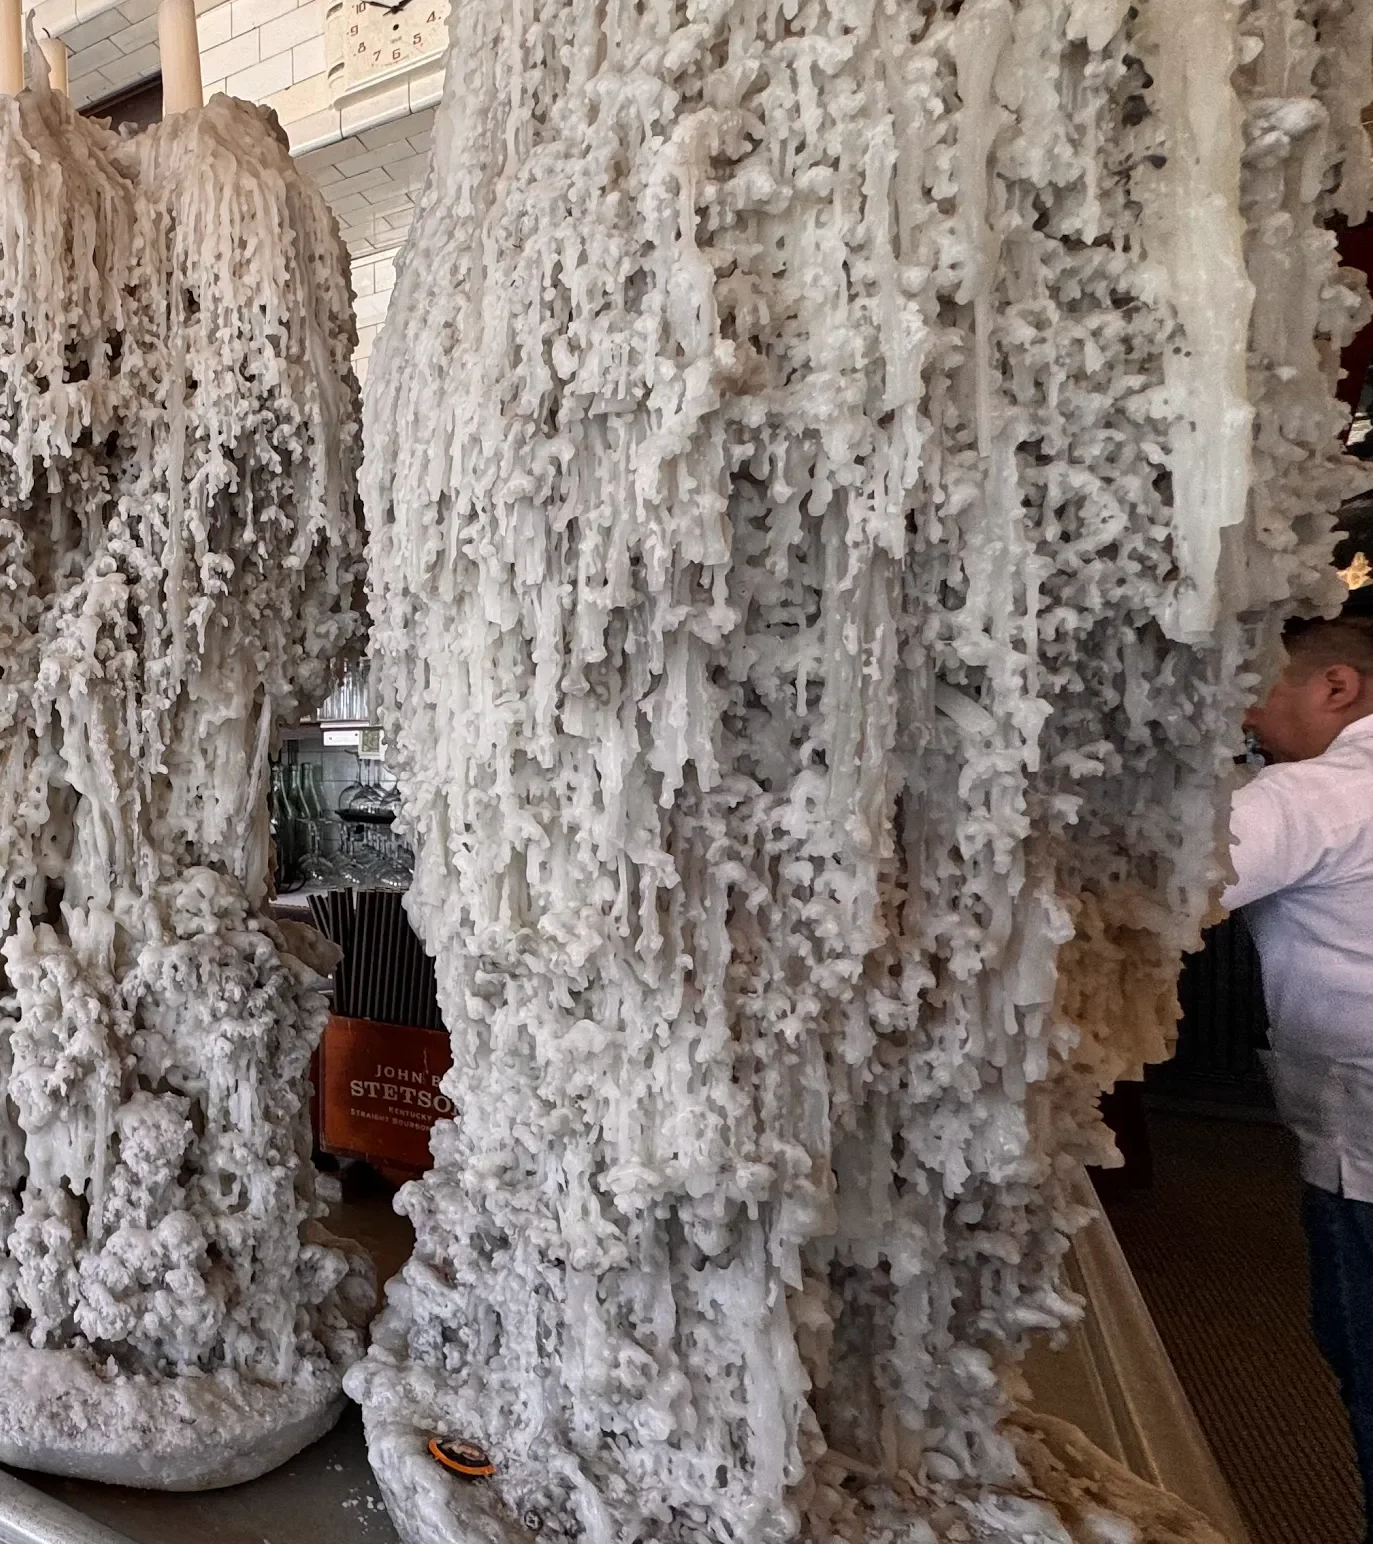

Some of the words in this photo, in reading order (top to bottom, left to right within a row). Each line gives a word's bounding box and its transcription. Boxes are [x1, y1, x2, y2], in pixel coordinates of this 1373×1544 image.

[355, 1, 366, 14] 10
[426, 11, 436, 23] 4
[350, 25, 359, 37] 9
[413, 33, 422, 45] 5
[358, 42, 366, 53] 8
[373, 50, 382, 61] 7
[392, 48, 401, 60] 6
[375, 1064, 422, 1084] JOHN
[350, 1108, 389, 1122] STRAIGHT
[388, 1106, 432, 1121] KENTUCKY
